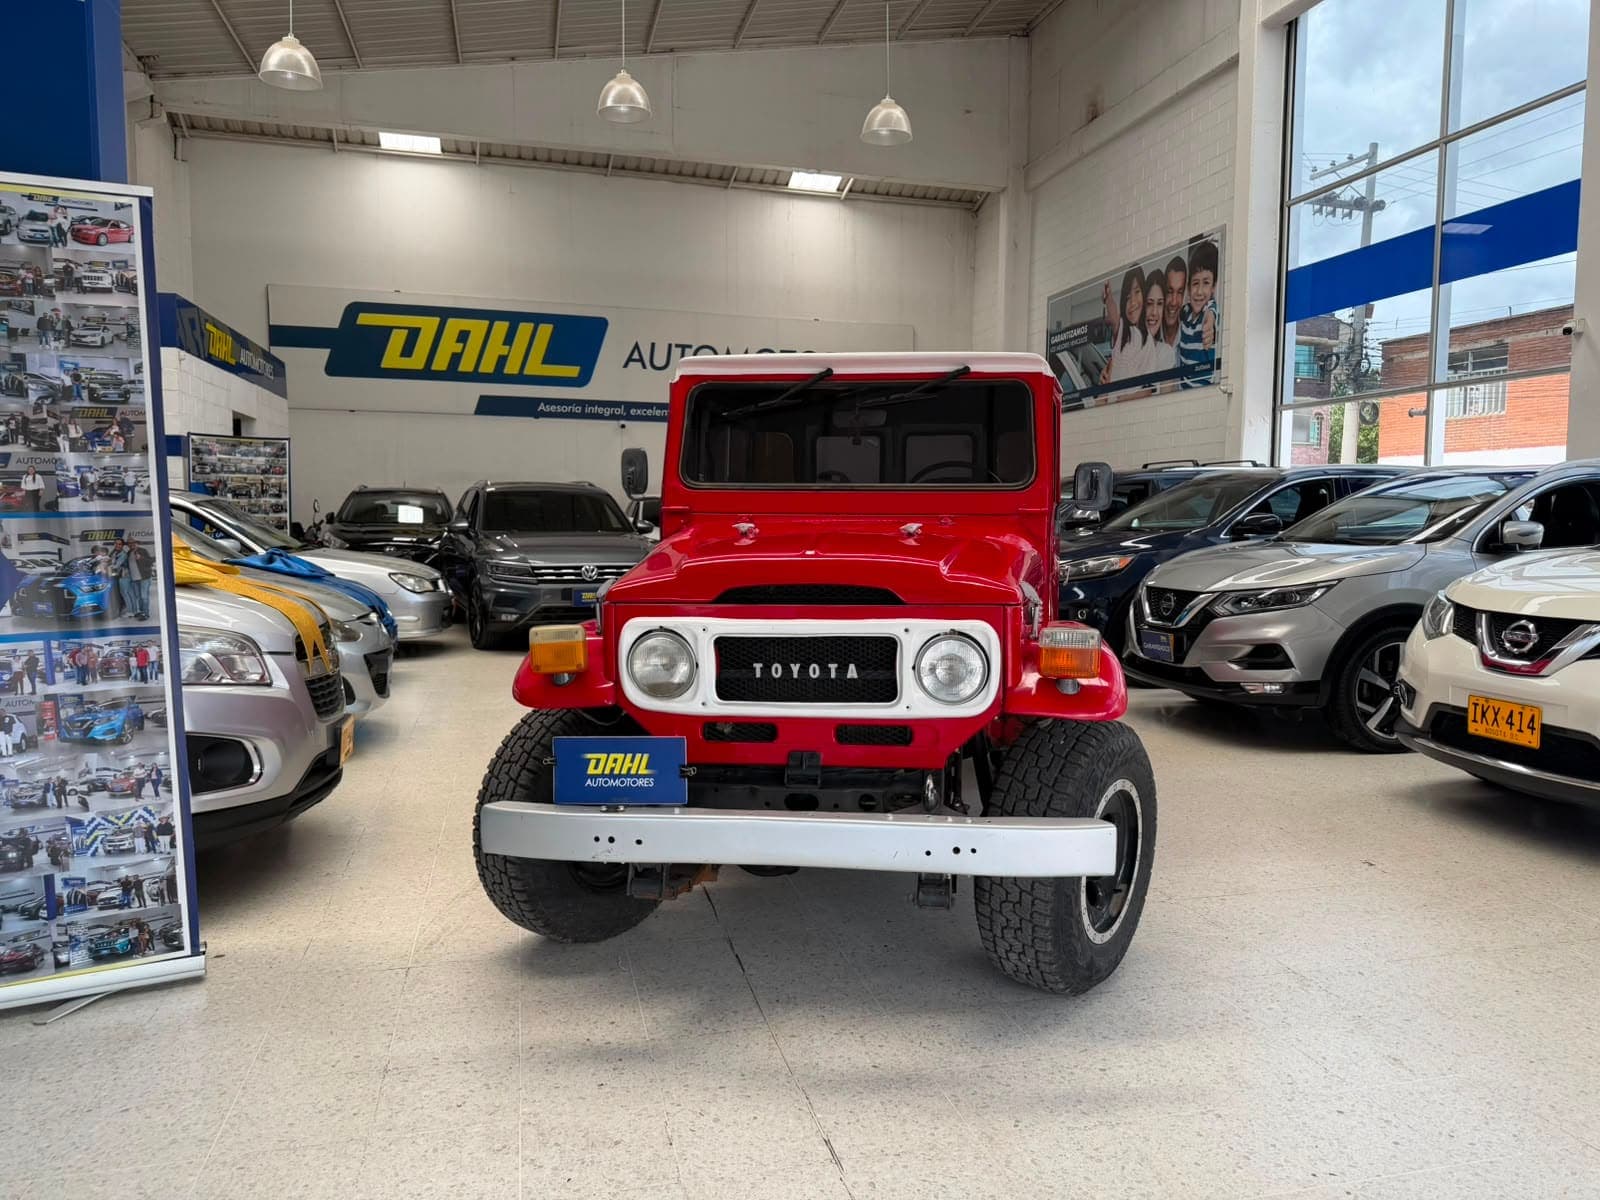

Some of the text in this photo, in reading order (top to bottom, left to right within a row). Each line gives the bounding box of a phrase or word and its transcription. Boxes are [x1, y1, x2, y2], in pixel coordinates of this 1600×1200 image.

[356, 312, 581, 377] DAHL
[1050, 324, 1088, 345] GARANTIZAMOS
[205, 322, 274, 380] DAHL AUTOMOTORES
[537, 402, 582, 413] Asesoría
[585, 404, 627, 417] integral,
[753, 663, 858, 678] TOYOTA
[1472, 702, 1536, 735] IKX 414
[581, 753, 657, 775] DAHL
[585, 778, 655, 787] AUTOMOTORES
